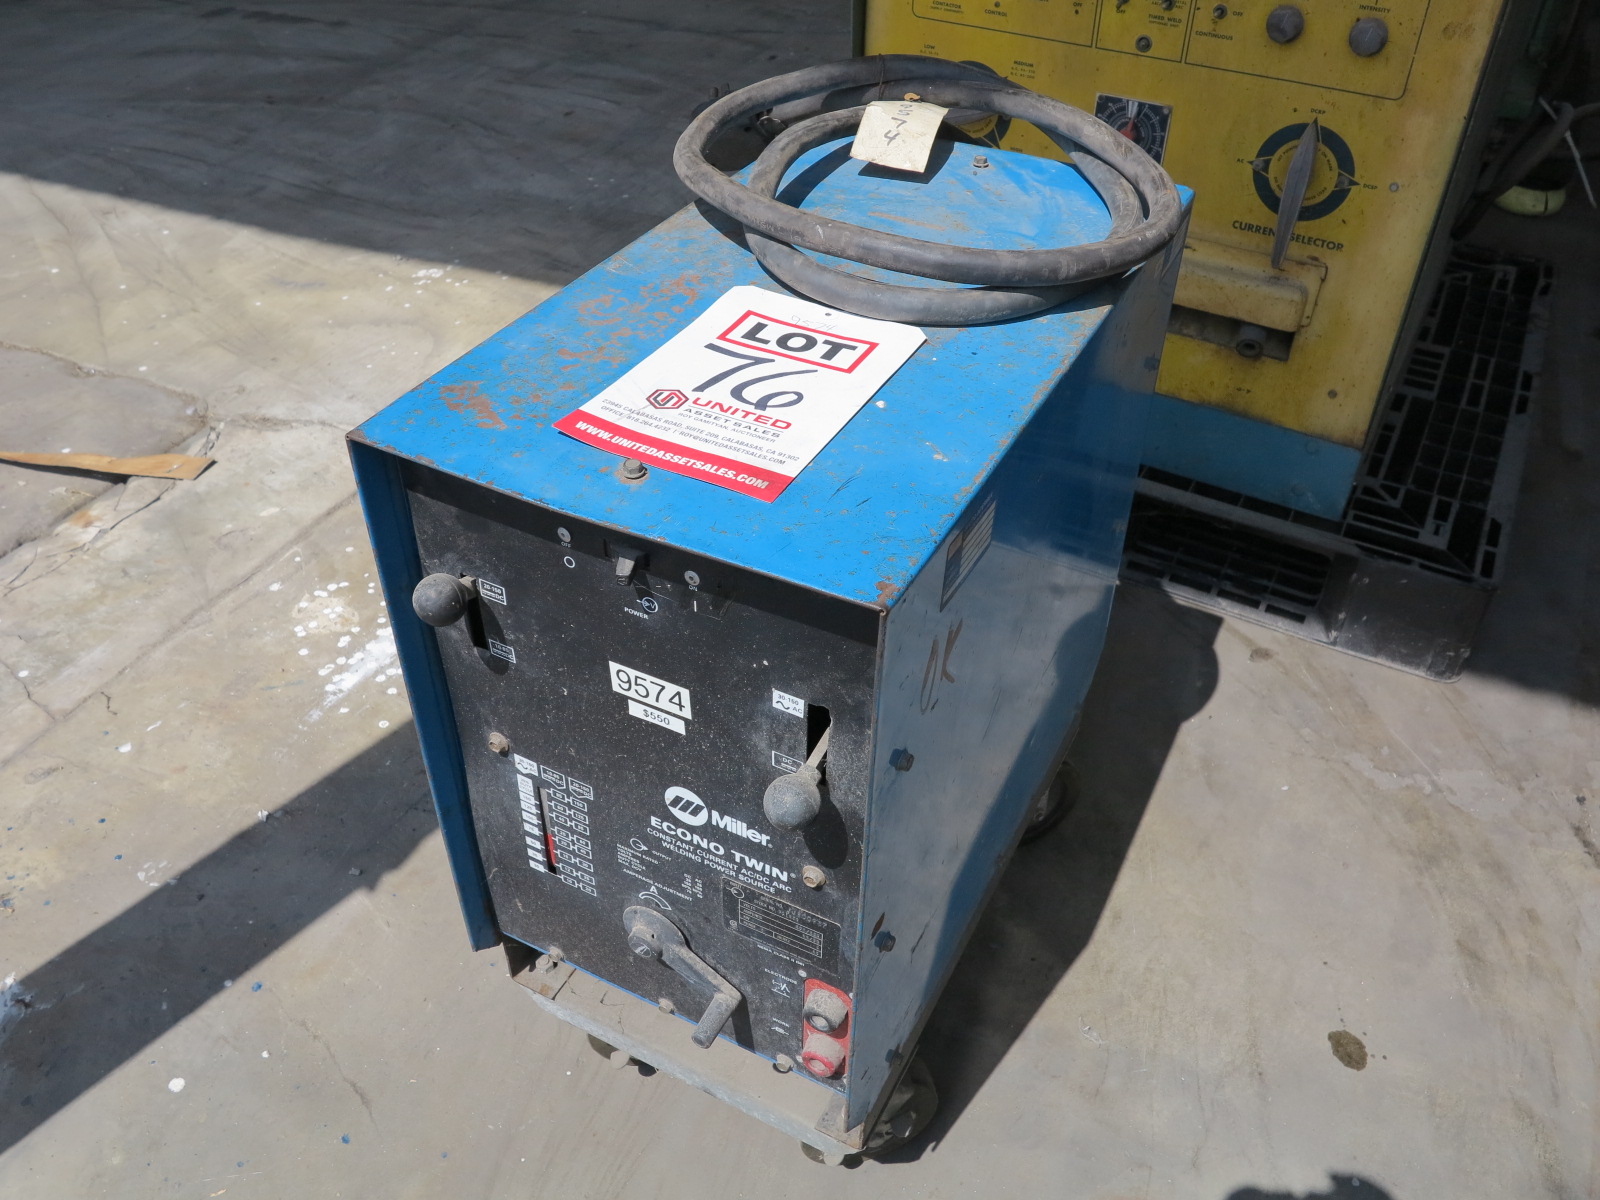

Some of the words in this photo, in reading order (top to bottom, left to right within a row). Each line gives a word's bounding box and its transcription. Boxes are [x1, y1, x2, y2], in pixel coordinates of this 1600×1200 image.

[984, 9, 1008, 17] CONTROL
[1359, 4, 1391, 14] INTENSITY
[1195, 31, 1233, 40] CONTINUOUS
[1232, 220, 1276, 238] CURREN
[1290, 232, 1344, 252] SELECTOR
[741, 321, 858, 361] LOT
[691, 343, 819, 411] 76
[683, 408, 731, 424] ASSET
[733, 421, 782, 438] SALES
[692, 397, 792, 430] UNITED
[600, 405, 626, 417] OFFICE
[626, 415, 671, 432] 818.264.4232
[678, 430, 786, 466] ROY@UNITEDASSETSALES.COM
[602, 399, 623, 409] 23945
[623, 406, 662, 422] CALABASAS
[684, 424, 705, 434] SUITE
[777, 451, 800, 461] 91302
[731, 428, 776, 443] AUCTIONEER
[575, 420, 770, 490] WWW.UNITEDASSETSALES.COM
[624, 606, 649, 620] POWER
[615, 668, 686, 712] 9574
[777, 693, 799, 706] 30-150
[642, 708, 670, 726] $550
[792, 706, 803, 714] AC
[782, 757, 793, 765] DC
[711, 809, 771, 847] Miller
[647, 827, 694, 852] CONSTANT
[696, 849, 739, 871] CURRENT
[740, 867, 770, 885] AC/DC
[772, 881, 792, 893] ARC
[650, 815, 725, 855] ECONO
[730, 849, 788, 882] TWIN
[652, 850, 672, 861] OUTPUT
[661, 840, 702, 863] WELDING
[704, 860, 736, 877] POWER
[738, 873, 776, 894] SOURCE
[622, 868, 654, 885] AMPERAGE
[654, 882, 693, 902] ADJUSTMENT
[649, 885, 658, 895] A
[764, 968, 798, 985] ELECTRODE
[772, 1017, 790, 1027] WORK
